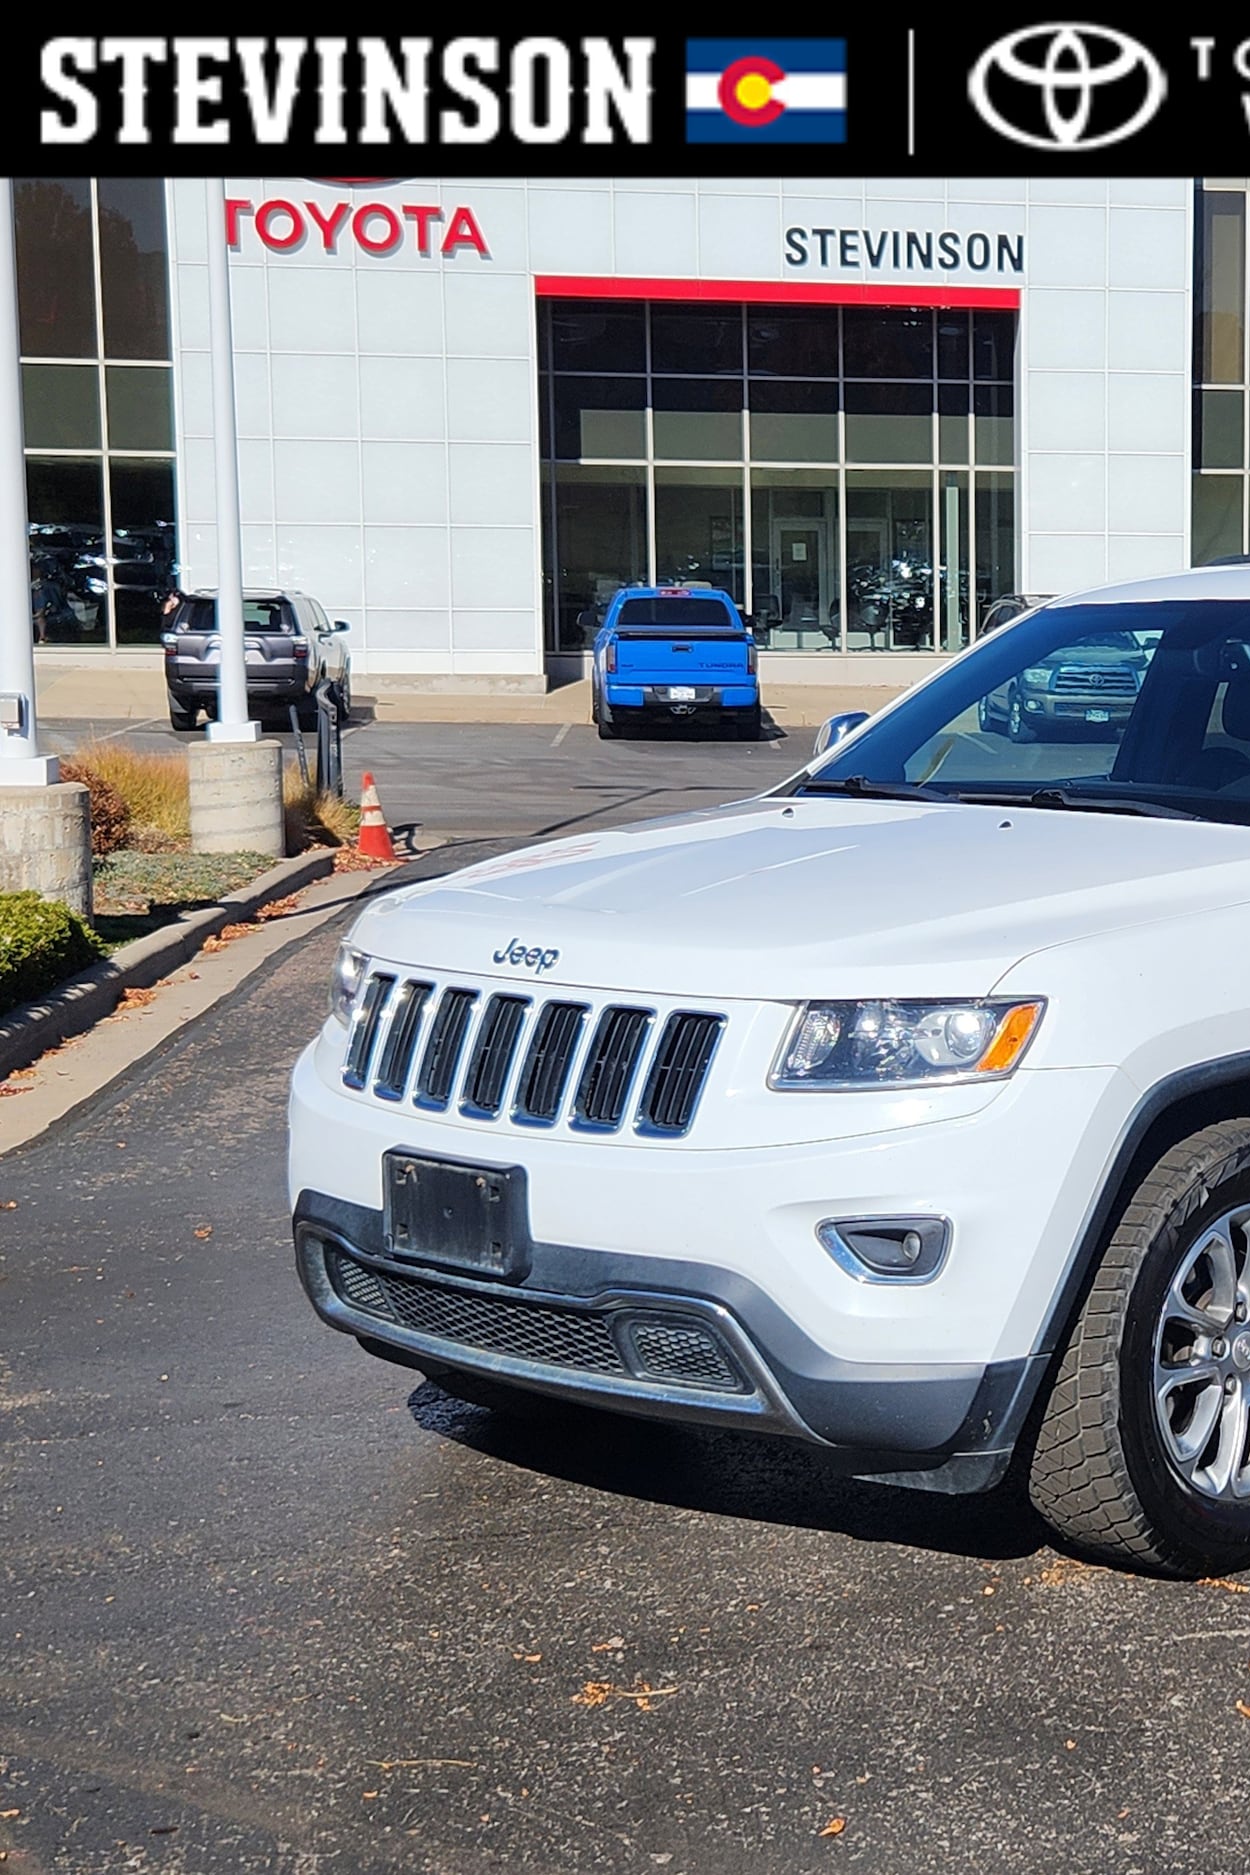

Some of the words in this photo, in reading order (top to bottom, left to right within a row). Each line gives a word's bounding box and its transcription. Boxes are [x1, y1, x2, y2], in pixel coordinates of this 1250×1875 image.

[224, 198, 489, 256] TOYOTA
[785, 227, 1024, 273] STEVINSON
[493, 937, 560, 974] Jeep
